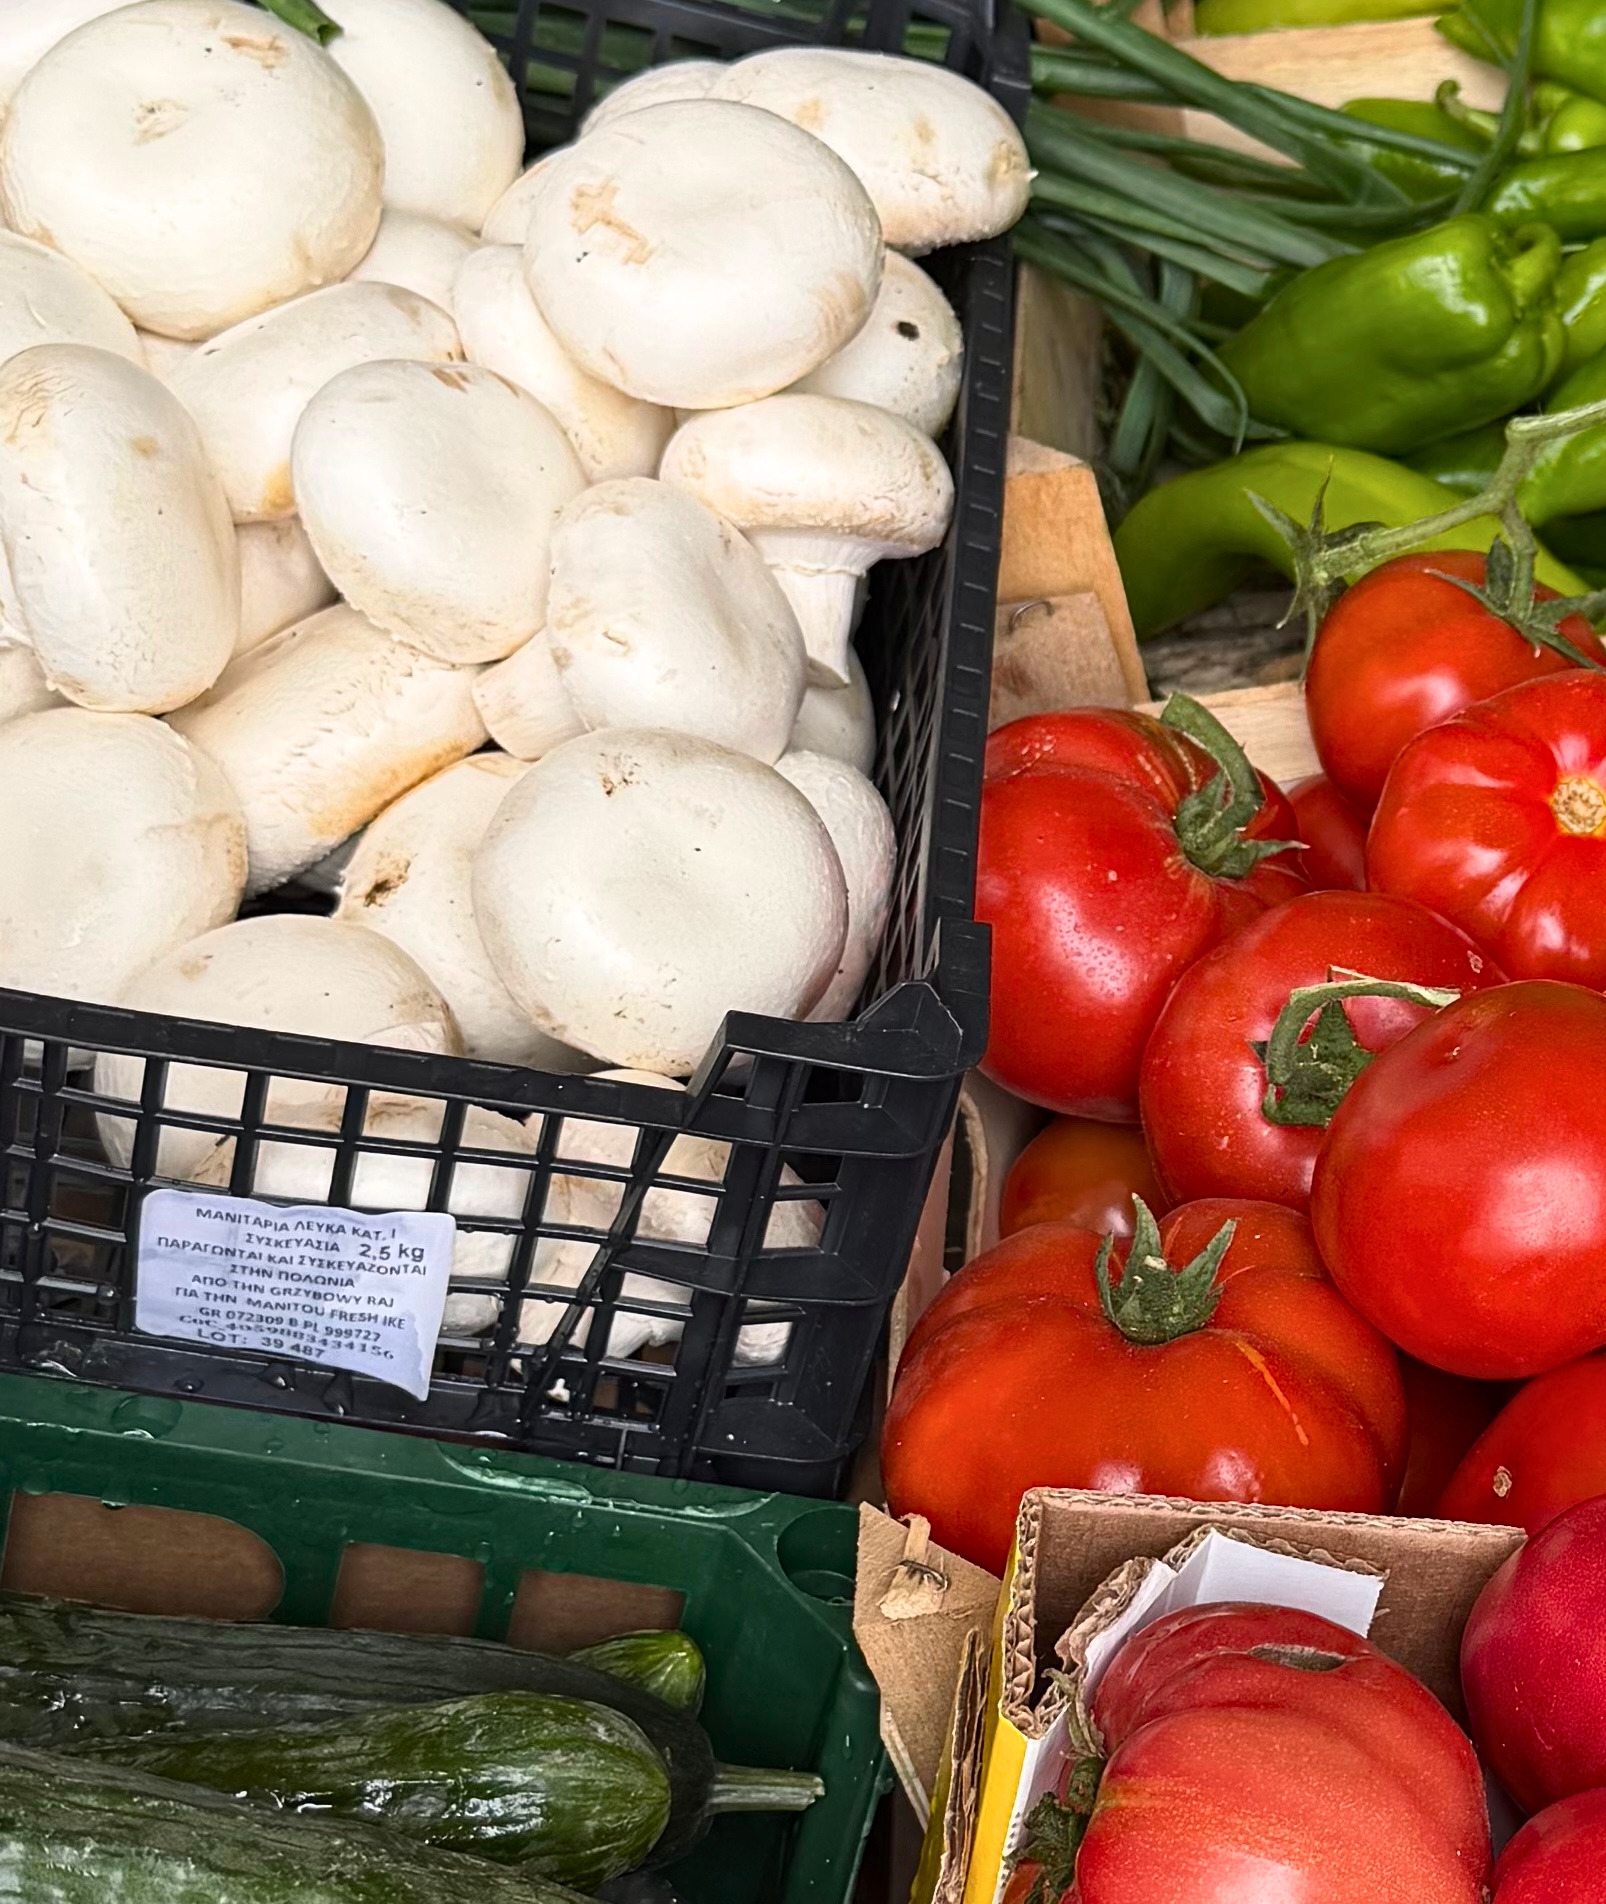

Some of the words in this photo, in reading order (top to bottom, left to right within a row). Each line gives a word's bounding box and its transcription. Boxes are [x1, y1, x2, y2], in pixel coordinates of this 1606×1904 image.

[196, 1208, 290, 1232] ΜΑΝΙΤΑΡΙΑ
[294, 1221, 346, 1235] ΛΕΥΚΑ
[157, 1236, 263, 1260] ΠΑΡΑΓΩΝΤΑΙ
[267, 1255, 294, 1265] ΚΑΙ
[298, 1254, 427, 1276] ΣΥΣΚΕΥΑΖΟΝΤΑΙ
[245, 1232, 340, 1252] ΣΥΣΚΕΥΑΣΙΑ
[358, 1243, 391, 1261] 2,5
[398, 1243, 425, 1263] kg
[191, 1274, 227, 1287] ΑΠΟ
[232, 1280, 265, 1294] ΤΗΝ
[269, 1287, 362, 1305] GRZYBOWY
[367, 1296, 395, 1308] RAJ
[229, 1264, 273, 1278] ΣΤΗΝ
[278, 1270, 356, 1288] ΠΟΛΩΝΙΑ
[175, 1287, 199, 1299] ΓΙΑ
[203, 1291, 238, 1304] ΤΗΝ
[246, 1297, 325, 1317] MANITOU
[329, 1308, 379, 1324] FRESH
[382, 1315, 407, 1330] IKE
[198, 1307, 222, 1319] GR
[303, 1320, 320, 1333] PL
[197, 1328, 248, 1345] LOT:
[261, 1336, 285, 1349] 39
[289, 1343, 326, 1359] 487
